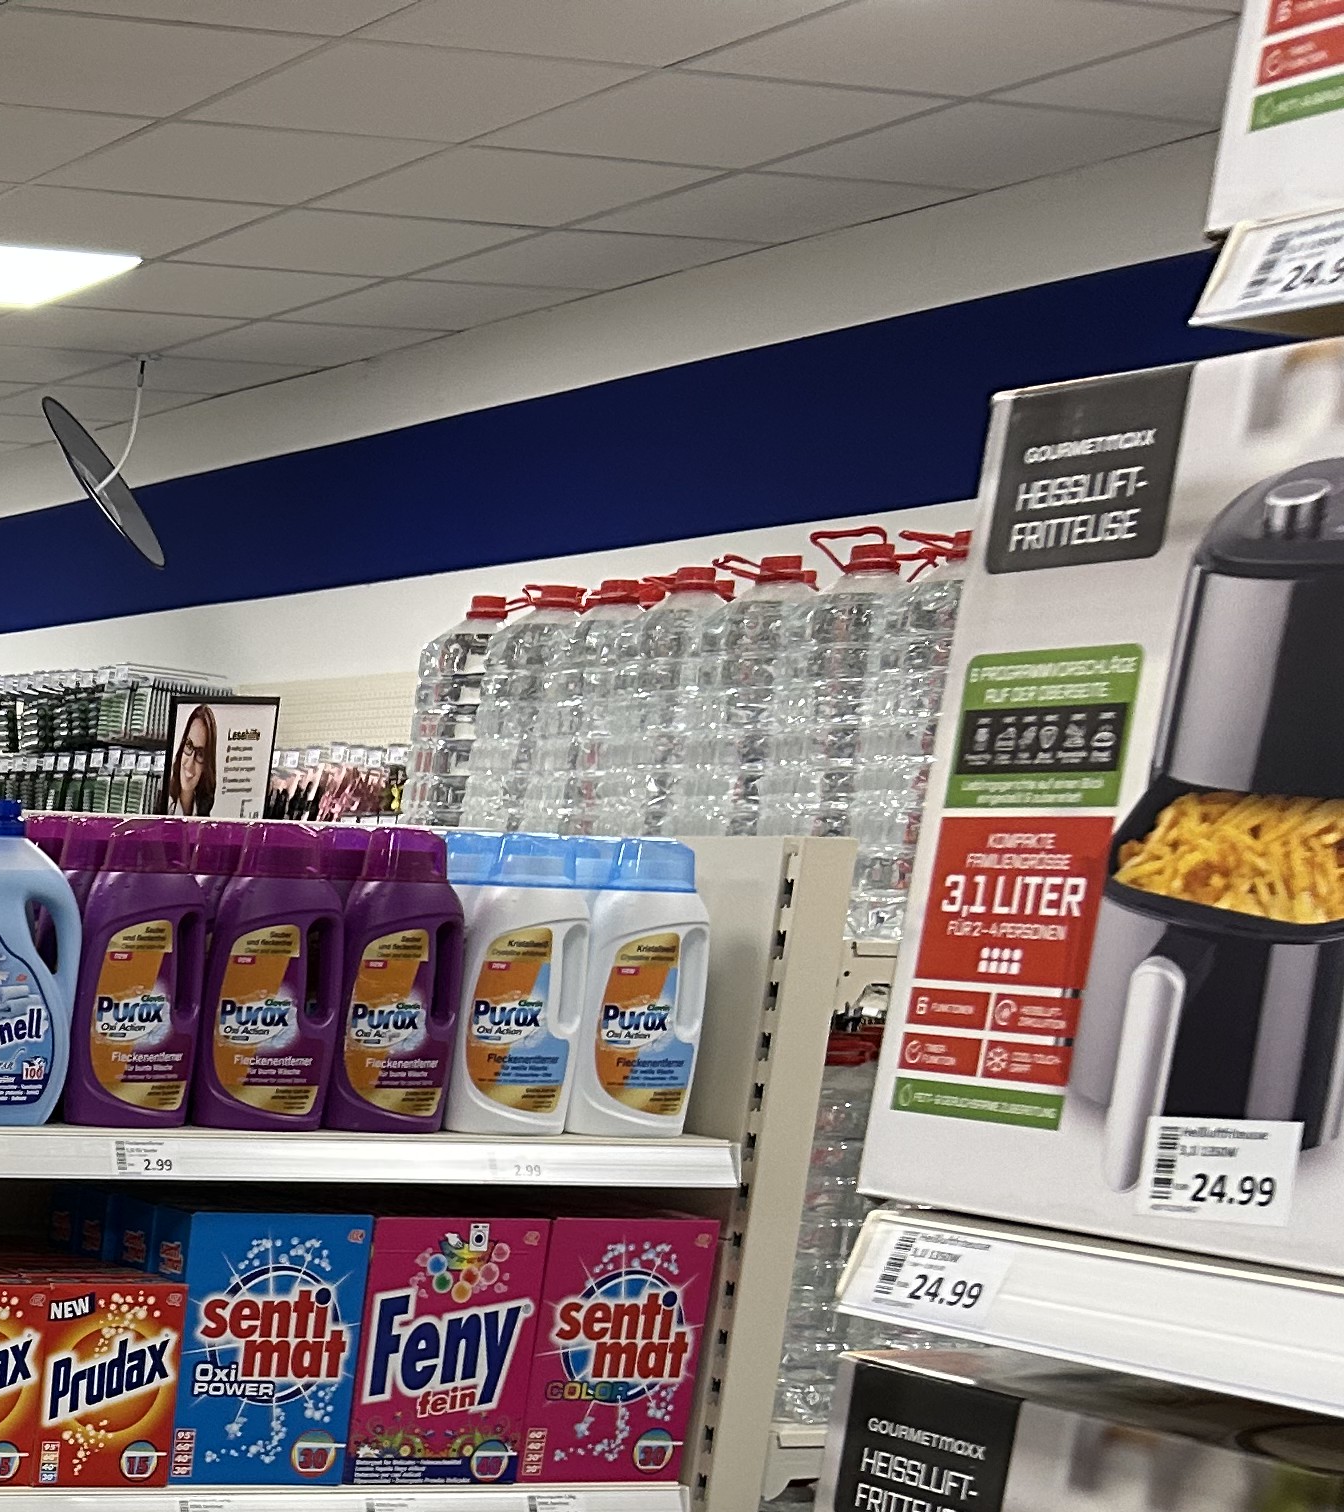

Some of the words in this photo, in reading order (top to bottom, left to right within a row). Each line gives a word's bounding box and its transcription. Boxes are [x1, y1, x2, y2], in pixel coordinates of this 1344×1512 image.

[1015, 466, 1148, 511] HEISSLUFT-
[1009, 509, 1141, 551] FRITTEUSE
[942, 875, 987, 918] 3,1
[993, 878, 1086, 916] LITER
[143, 1158, 172, 1172] 2.99
[1190, 1174, 1276, 1207] 24.99
[200, 1287, 332, 1337] senti
[556, 1290, 678, 1339] senti
[241, 1332, 346, 1379] mat
[368, 1294, 524, 1407] Feny
[592, 1333, 689, 1378] mat
[50, 1335, 169, 1420] Prudax
[194, 1382, 275, 1397] POWER
[195, 1365, 237, 1382] Oxi
[546, 1382, 628, 1400] COLOR
[417, 1387, 477, 1417] fein
